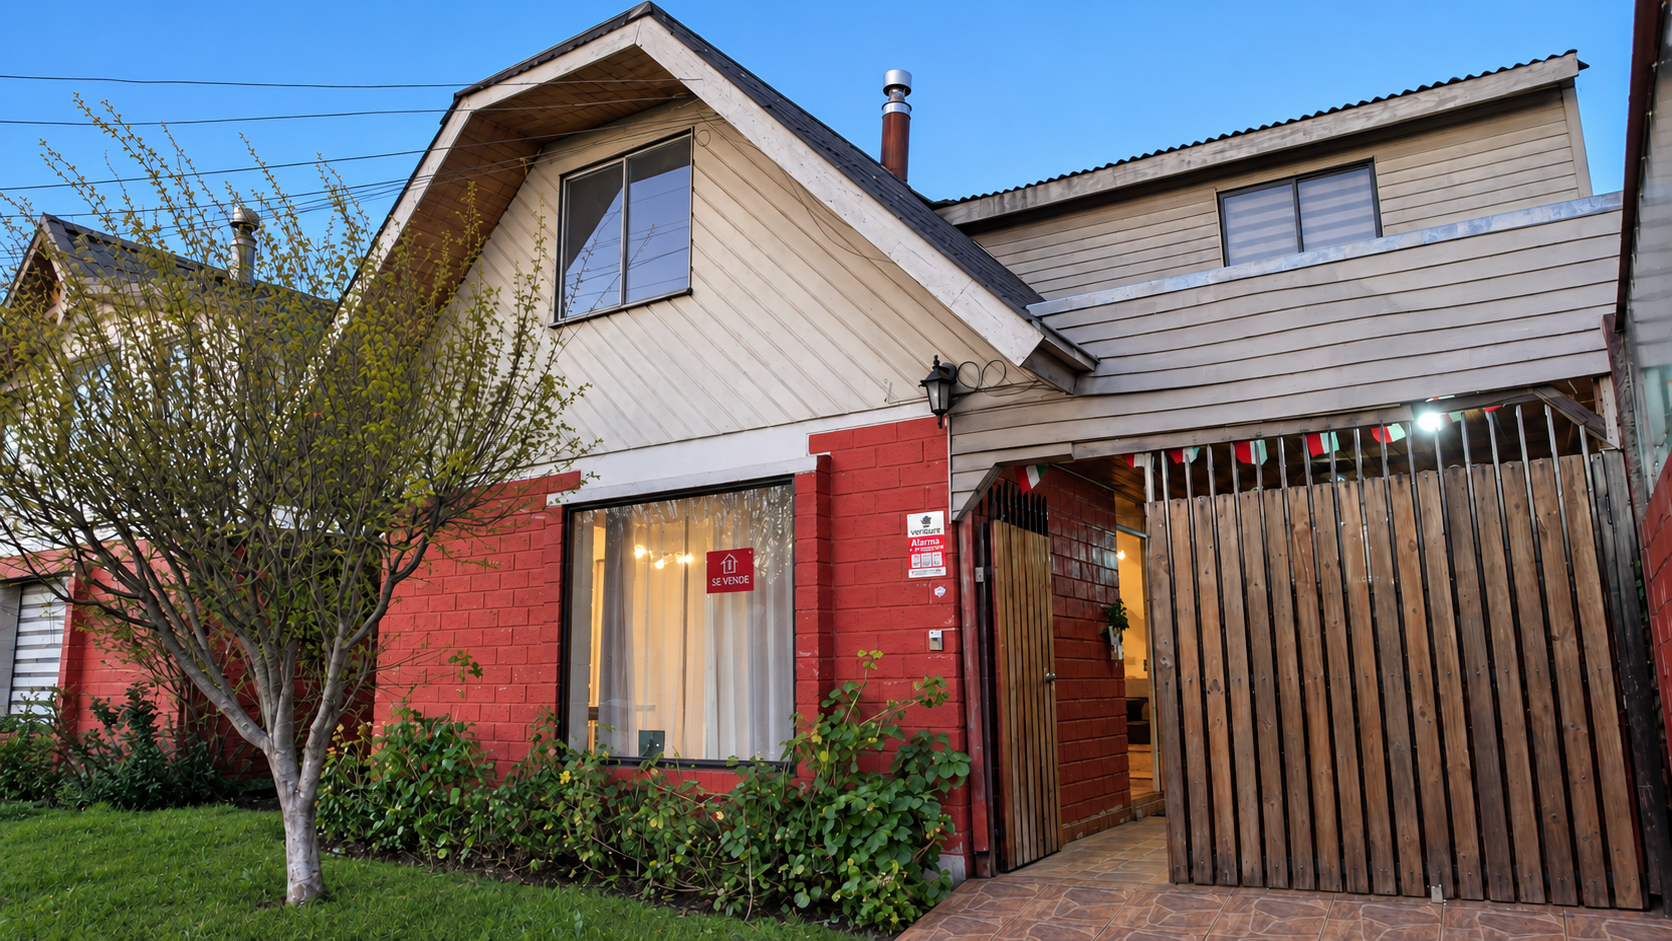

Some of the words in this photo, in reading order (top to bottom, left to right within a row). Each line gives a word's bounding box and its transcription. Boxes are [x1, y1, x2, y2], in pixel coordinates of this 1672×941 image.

[911, 538, 940, 547] Alarma
[711, 577, 721, 587] SE
[722, 575, 750, 586] VENDE
